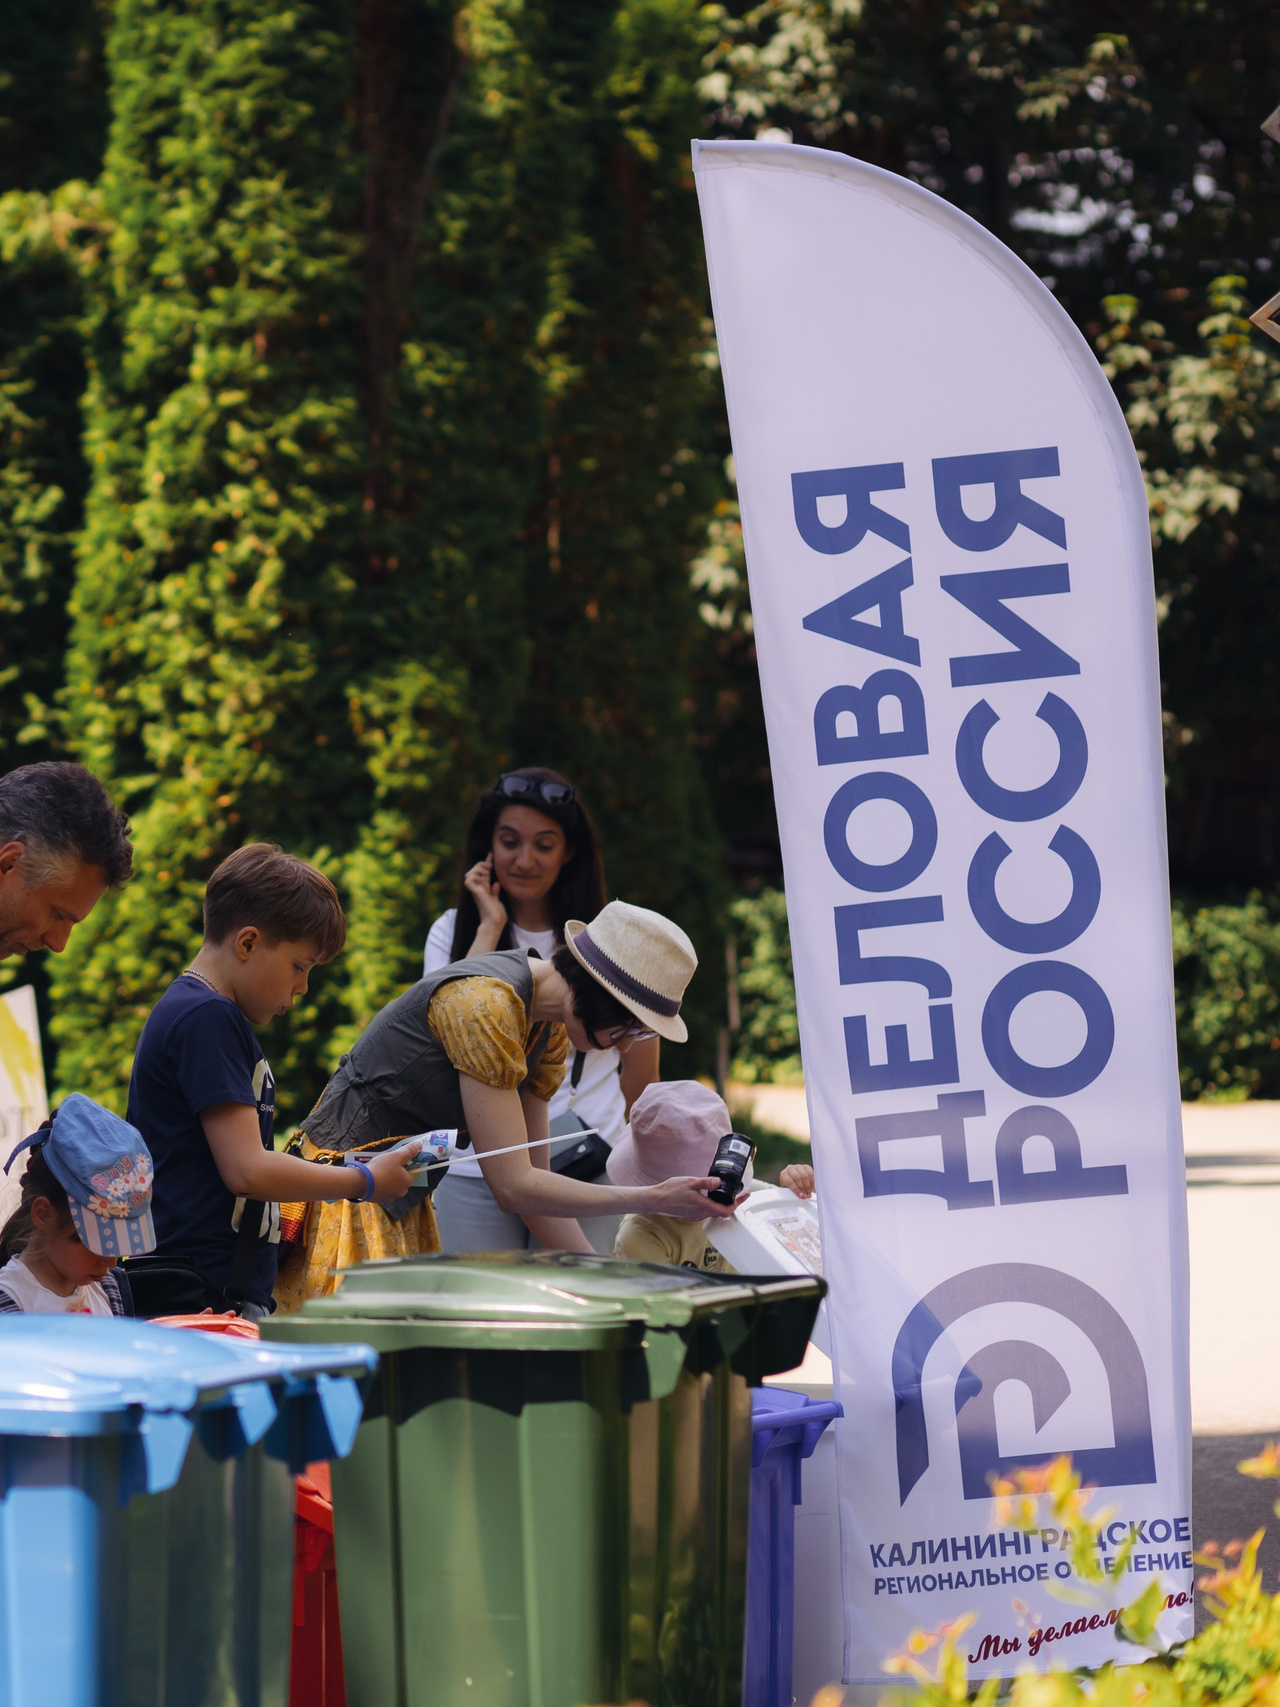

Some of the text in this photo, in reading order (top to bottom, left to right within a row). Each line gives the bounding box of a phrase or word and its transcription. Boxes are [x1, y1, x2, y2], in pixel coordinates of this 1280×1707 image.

[790, 462, 995, 1211] ДЕЛОВАЯ
[931, 446, 1129, 1206] РОССИЯ
[874, 1562, 1050, 1595] РЕГИОНАЛЬНОЕ
[968, 1633, 1022, 1664] Мы
